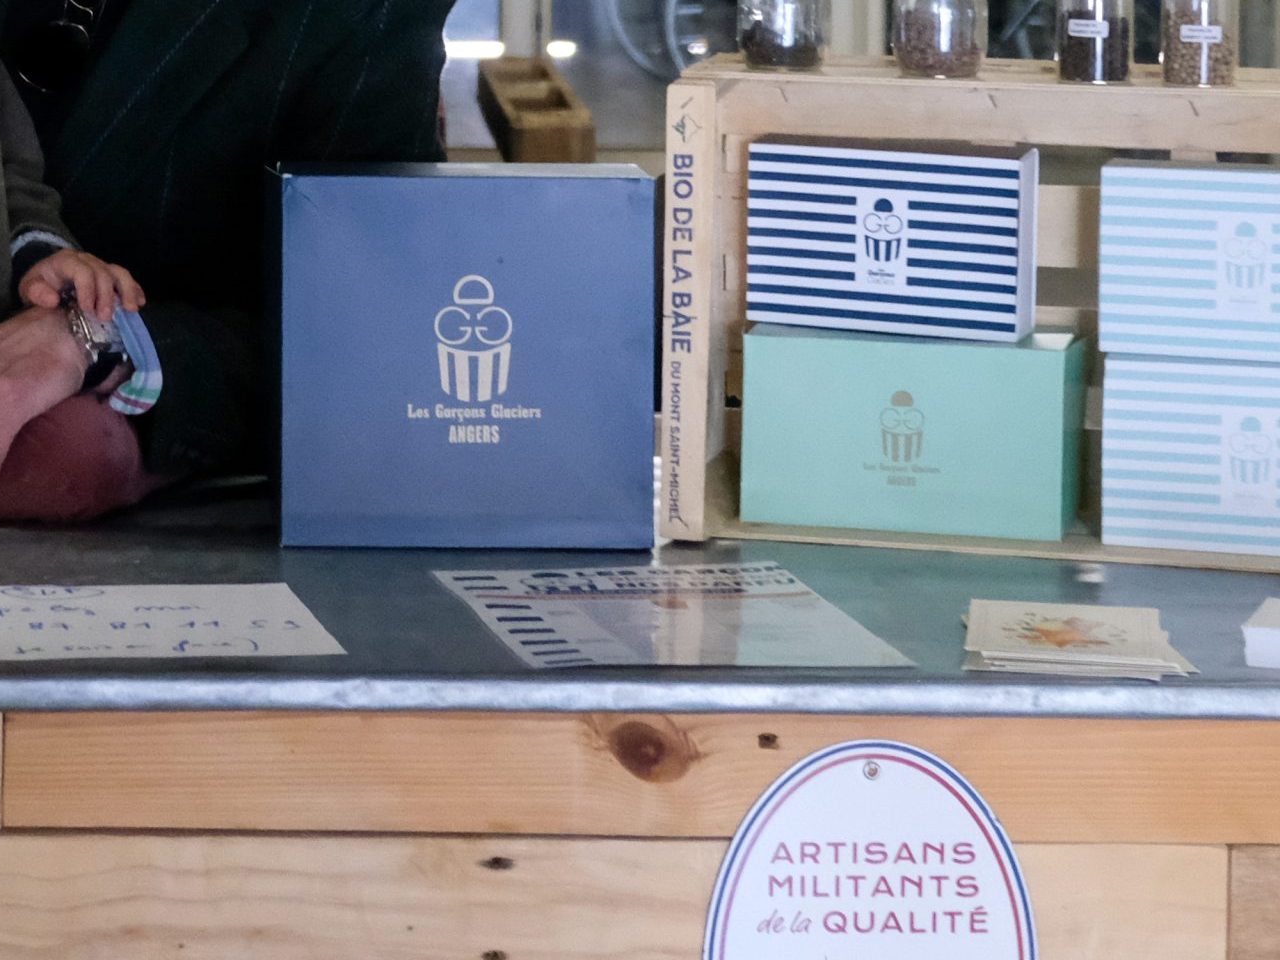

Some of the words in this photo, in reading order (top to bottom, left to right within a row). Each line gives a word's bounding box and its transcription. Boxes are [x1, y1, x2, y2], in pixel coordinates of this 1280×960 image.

[672, 153, 693, 200] BIO
[672, 207, 693, 243] DE
[671, 249, 693, 284] LA
[671, 290, 692, 354] BAIE
[670, 361, 682, 381] DU
[407, 403, 430, 419] Les
[435, 403, 486, 422] Garçons
[491, 403, 542, 419] Glaciers
[669, 385, 681, 422] MONT
[448, 424, 500, 444] ANGERS
[770, 841, 977, 865] ARTISANS
[769, 874, 980, 898] MILITANTS
[756, 909, 786, 934] de
[786, 909, 812, 934] la
[823, 905, 990, 935] QUALITÉ
